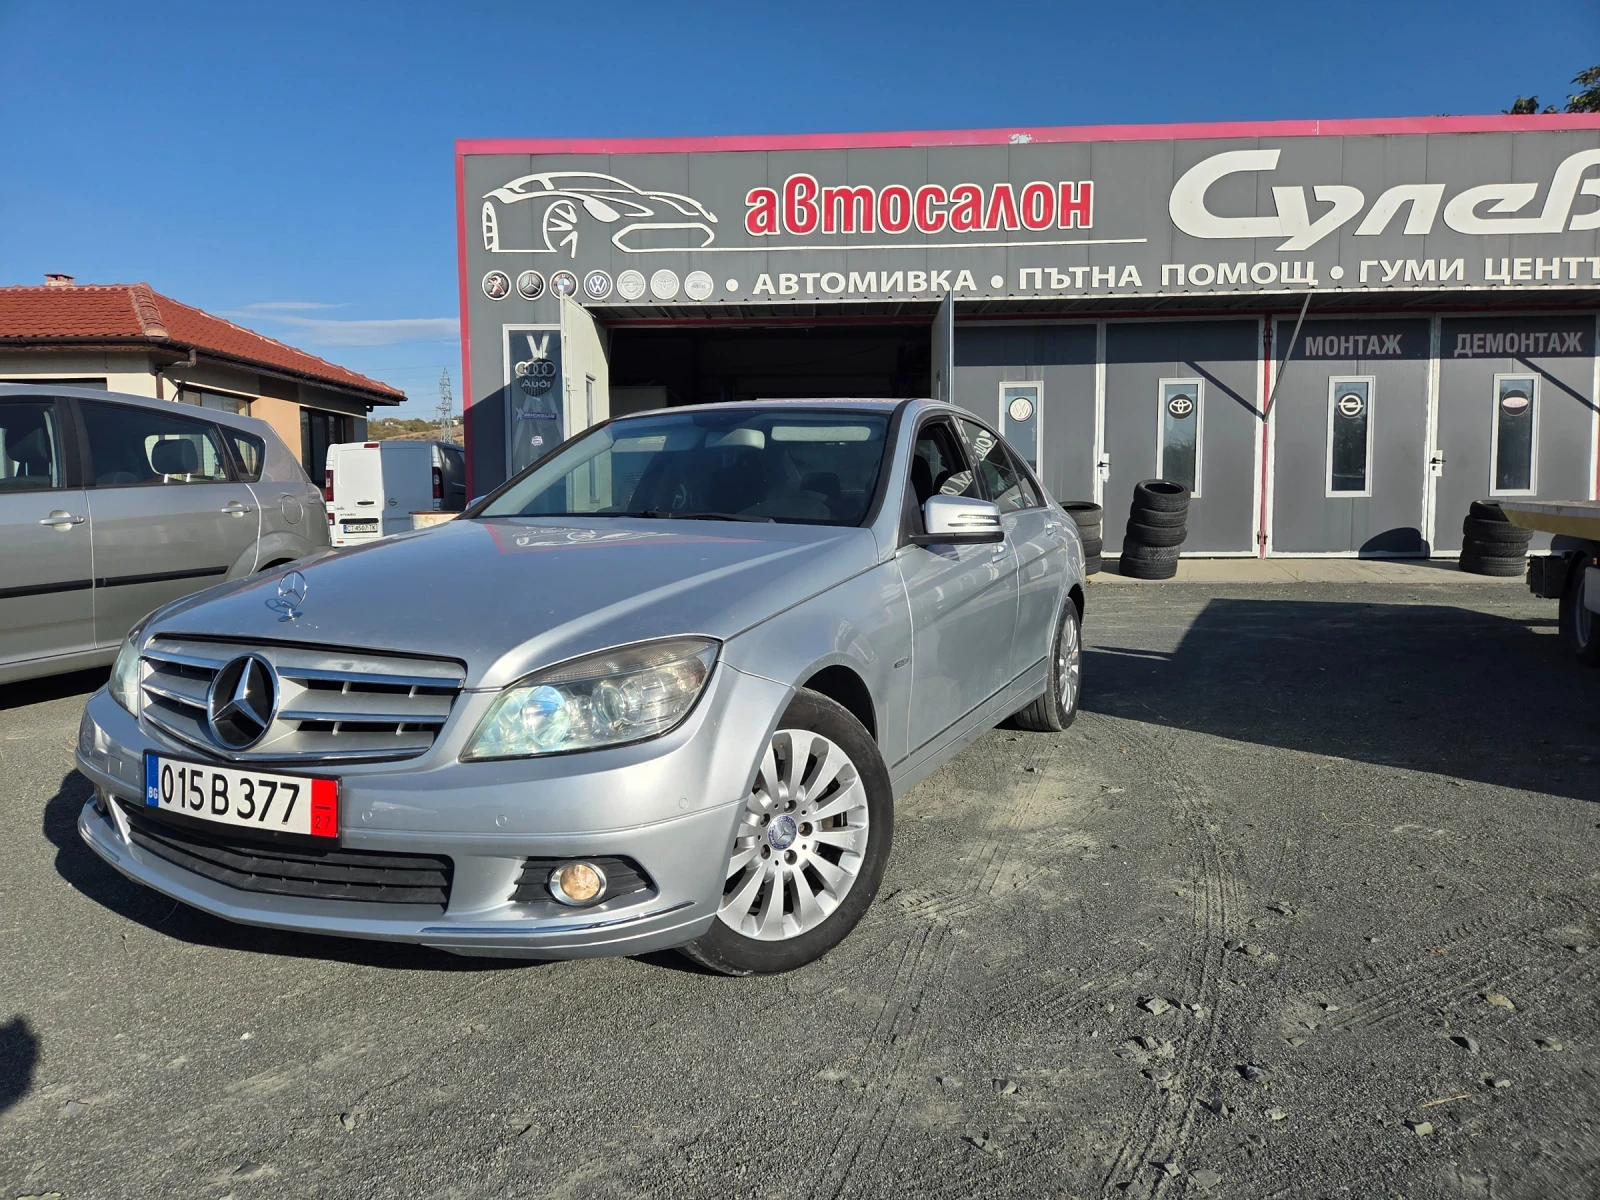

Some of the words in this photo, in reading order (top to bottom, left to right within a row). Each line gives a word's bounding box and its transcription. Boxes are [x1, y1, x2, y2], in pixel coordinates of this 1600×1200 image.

[745, 173, 1094, 236] автосалон
[752, 269, 978, 296] АВТОМИВКА
[1019, 264, 1143, 290] ПЪТНА
[1161, 260, 1319, 286] ПОМОЩ
[1359, 257, 1465, 283] ГУМИ
[1305, 334, 1403, 356] МОНТАЖ
[1453, 331, 1584, 358] ДЕМОНТАЖ
[521, 379, 551, 388] Audi
[148, 786, 159, 799] BG
